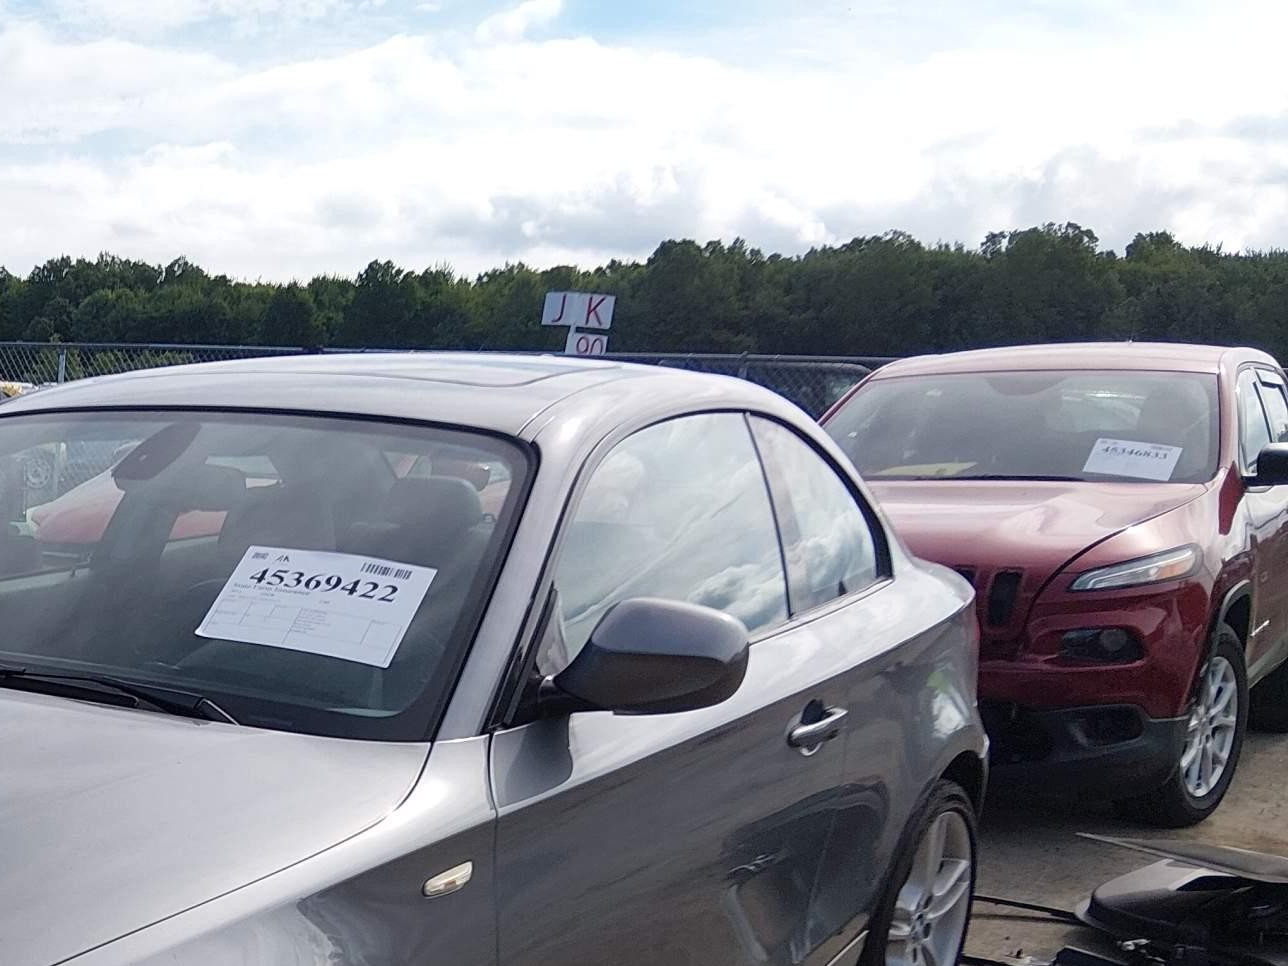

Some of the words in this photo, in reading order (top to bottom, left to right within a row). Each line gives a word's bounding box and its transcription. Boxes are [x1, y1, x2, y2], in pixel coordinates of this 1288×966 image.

[551, 293, 569, 323] J
[584, 296, 607, 326] K
[249, 567, 399, 603] 45369422
